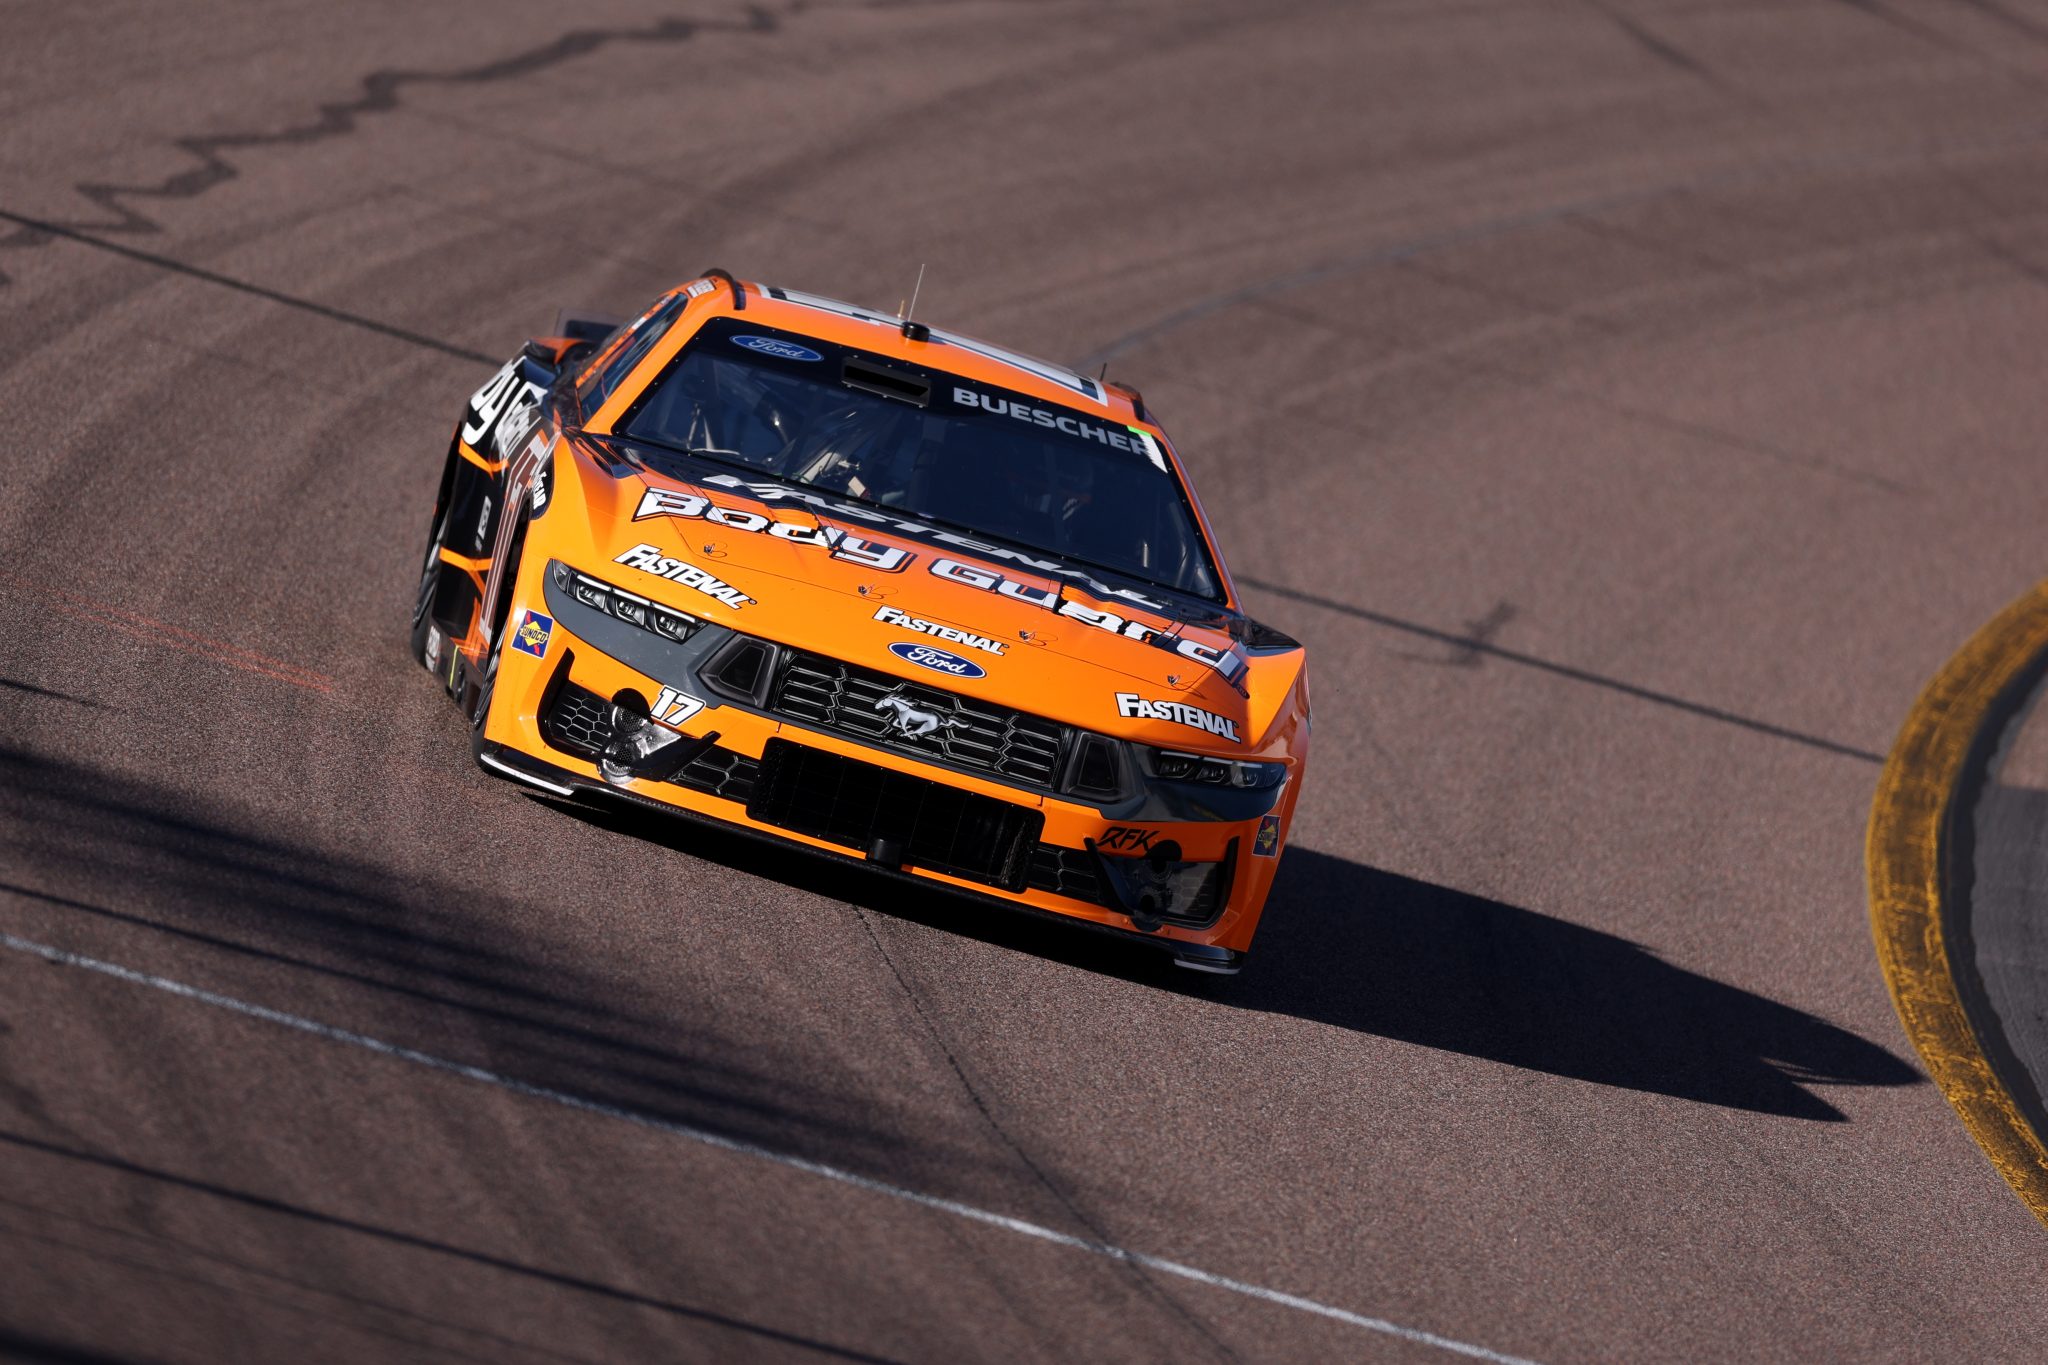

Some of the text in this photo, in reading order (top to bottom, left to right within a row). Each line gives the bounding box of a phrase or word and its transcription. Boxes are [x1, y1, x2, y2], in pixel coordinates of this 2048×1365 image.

[747, 338, 805, 358] Ford
[613, 543, 750, 610] FASTENAL
[520, 625, 548, 643] SUNOCO
[873, 604, 1006, 656] FASTENAL
[907, 646, 965, 674] Ford
[650, 686, 706, 728] 17
[1115, 692, 1241, 744] FASTENAL
[1096, 826, 1160, 851] RFK
